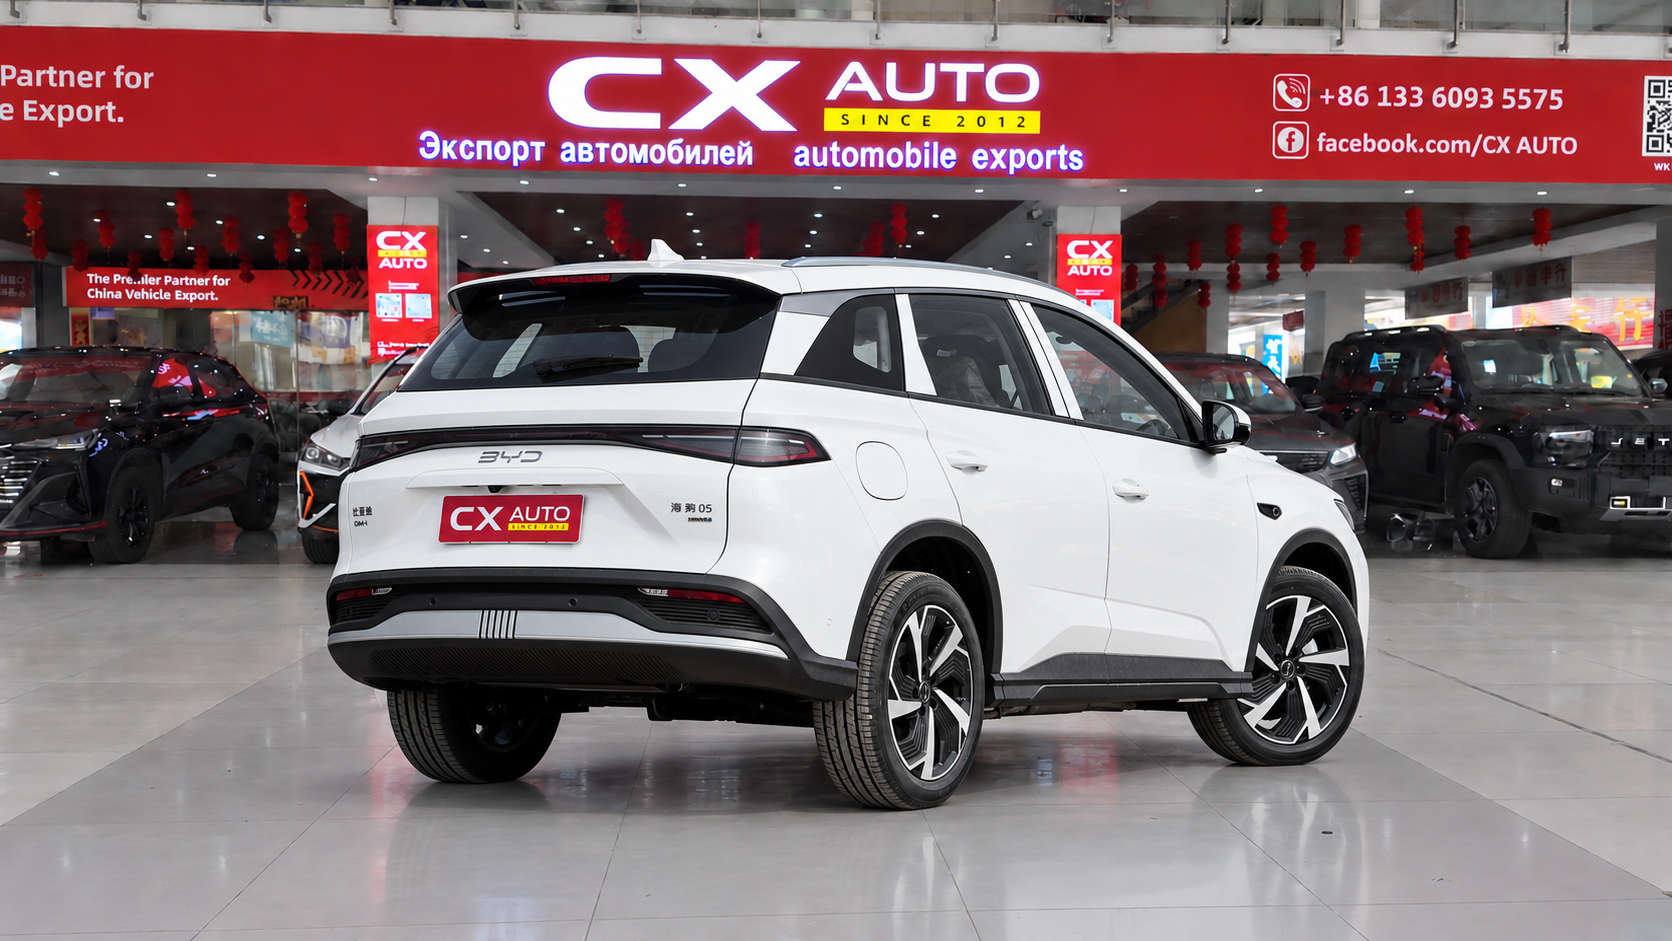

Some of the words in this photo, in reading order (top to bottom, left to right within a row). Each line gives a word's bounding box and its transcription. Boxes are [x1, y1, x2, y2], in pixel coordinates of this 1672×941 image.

[0, 64, 106, 88] Partner
[113, 65, 154, 89] for
[825, 61, 1040, 103] AUTO
[548, 56, 801, 132] CX
[1319, 86, 1369, 107] +86
[1377, 86, 1424, 108] 133
[1431, 87, 1494, 109] 6093
[1501, 88, 1564, 110] 5575
[23, 100, 124, 128] Export.
[841, 114, 931, 127] SINCE
[956, 116, 1026, 128] 2012
[418, 130, 546, 167] Экспорт
[559, 138, 754, 166] автомобилей
[1317, 132, 1511, 157] facebook.com/CX
[1516, 136, 1578, 155] AUTO
[793, 141, 957, 170] automobile
[971, 144, 1084, 175] exports
[376, 231, 427, 251] CX
[1066, 240, 1113, 259] CX
[378, 257, 428, 269] AUTO
[1067, 265, 1113, 276] AUTO
[86, 273, 110, 284] The
[164, 275, 210, 286] Partner
[212, 275, 231, 287] for
[86, 288, 122, 299] China
[125, 289, 171, 300] Vehicle
[174, 290, 219, 303] Export.
[478, 450, 542, 463] BYD
[450, 506, 504, 531] CX
[508, 506, 571, 522] AUTO
